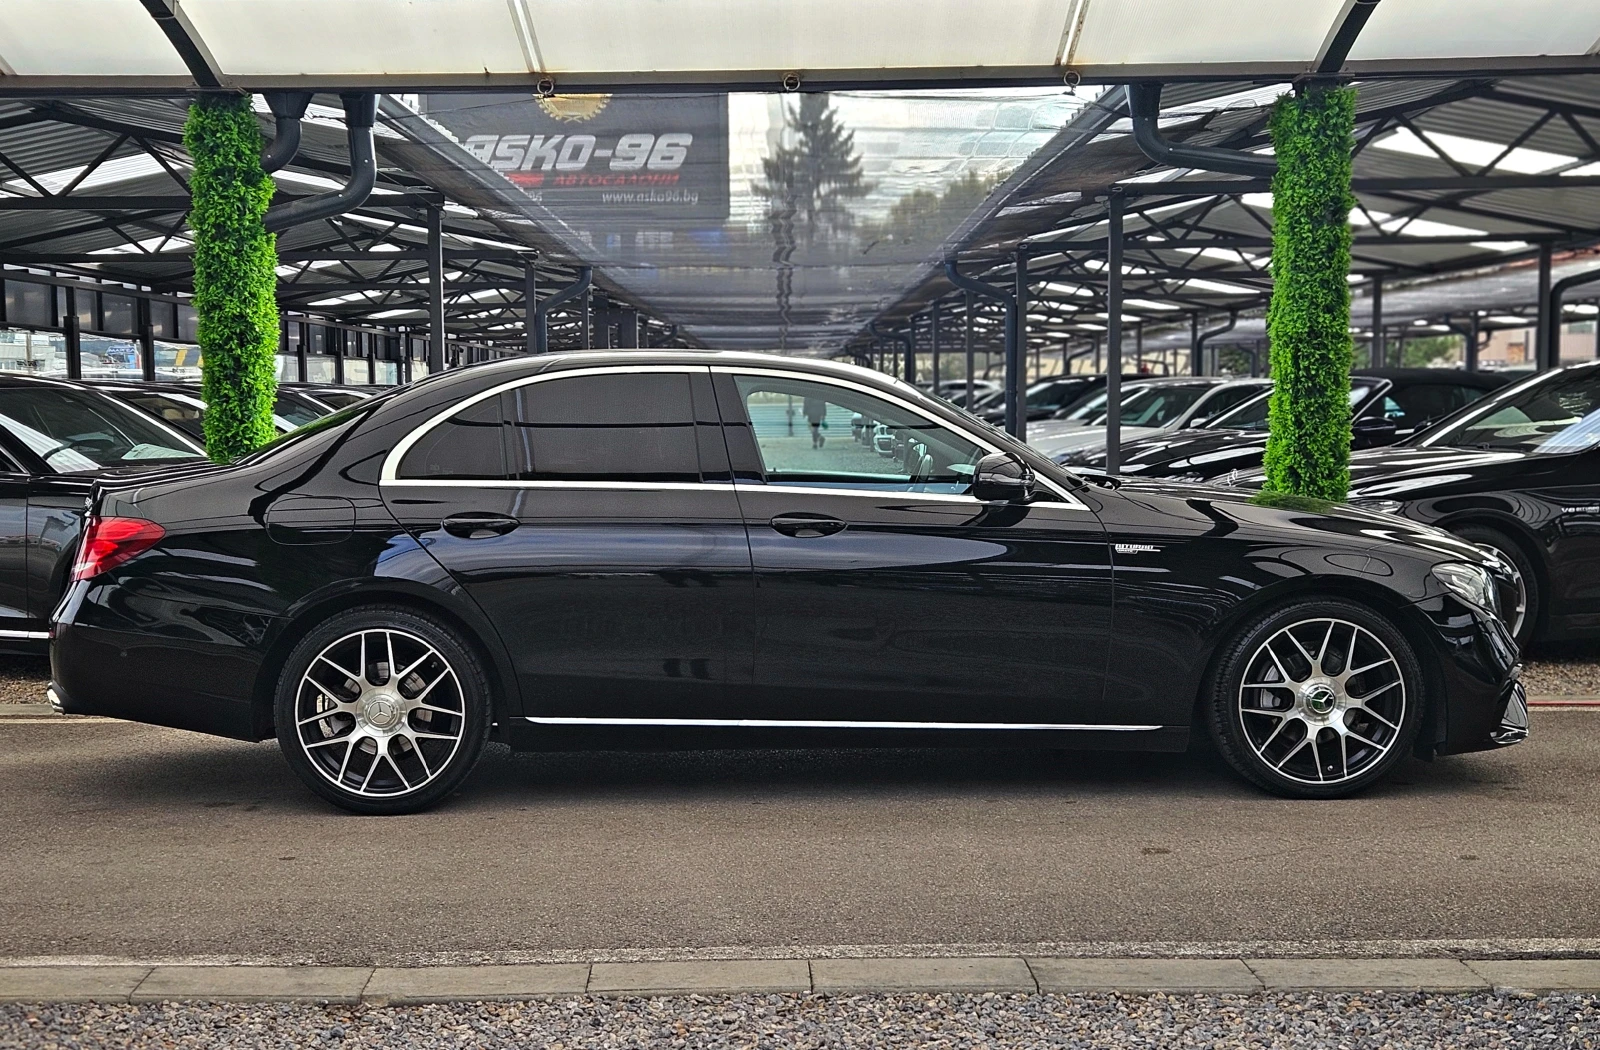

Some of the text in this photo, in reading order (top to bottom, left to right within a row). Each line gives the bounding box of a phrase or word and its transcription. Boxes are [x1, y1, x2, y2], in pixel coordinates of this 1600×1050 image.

[463, 133, 694, 171] ASKO-96
[553, 173, 680, 186] АВТОСАЛОНИ
[602, 189, 699, 205] www.asko96.bg
